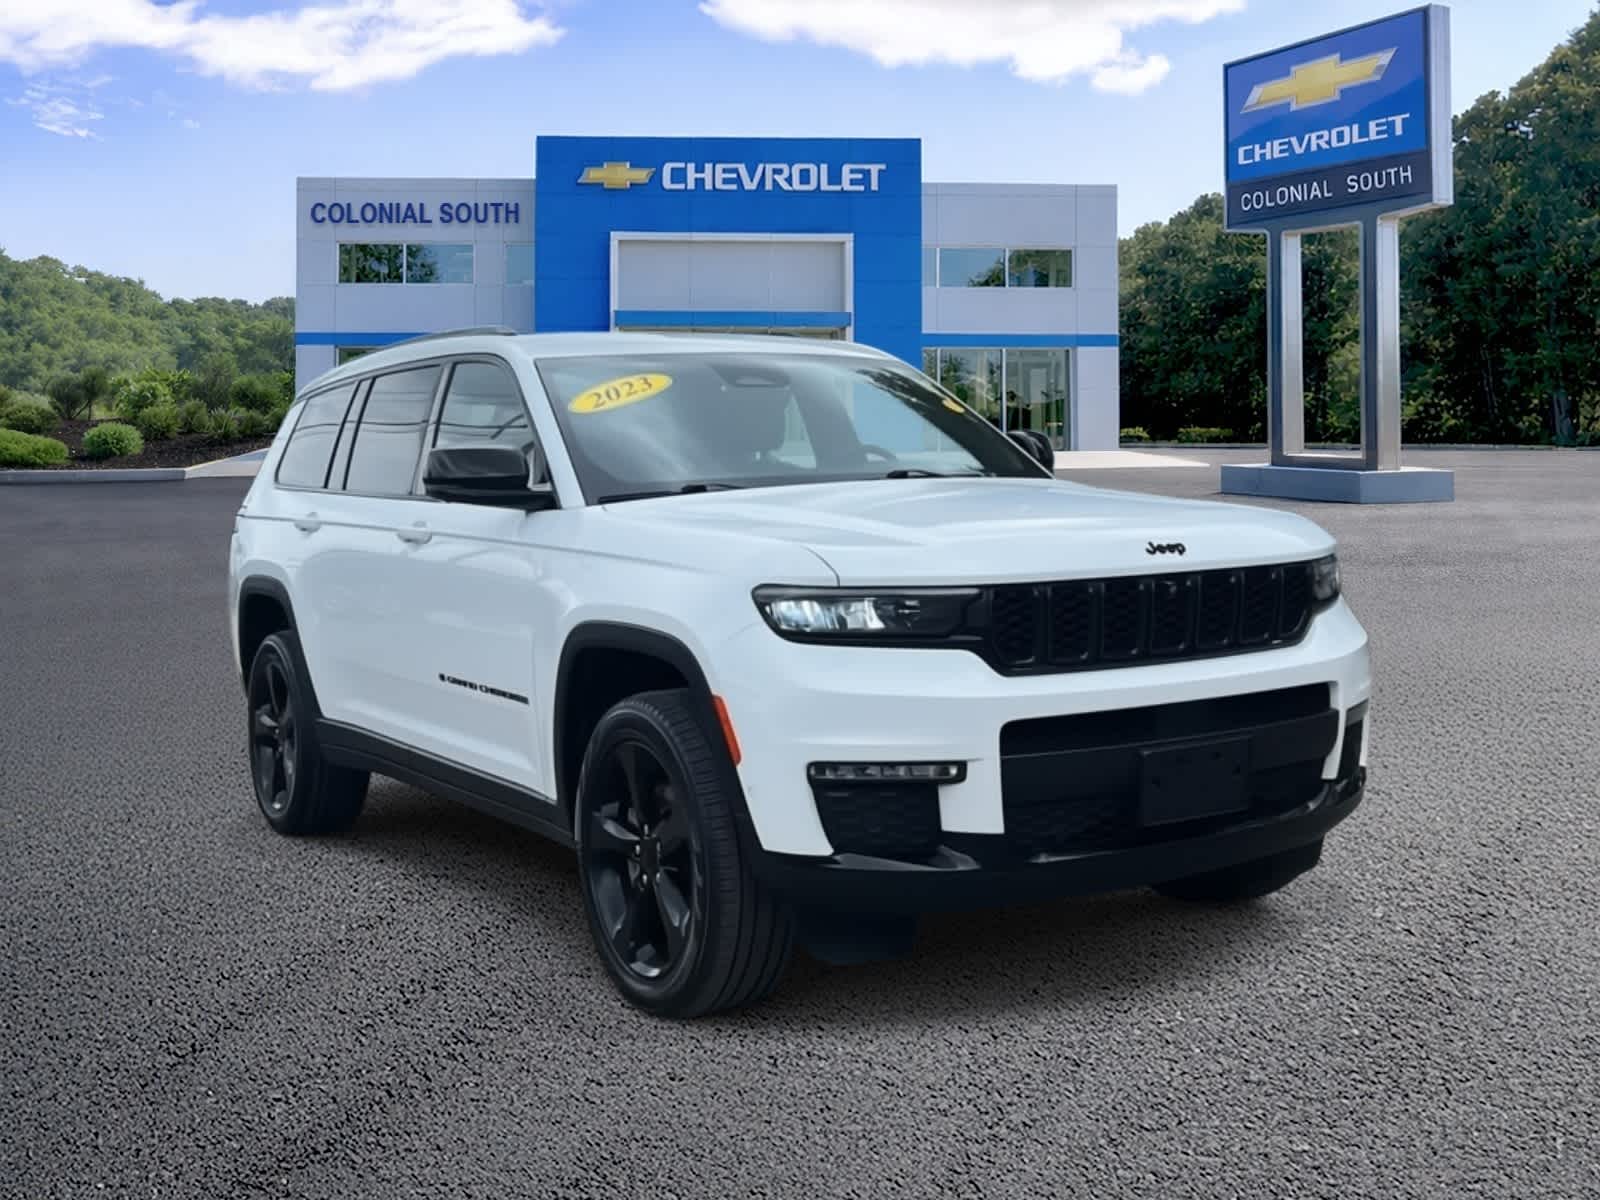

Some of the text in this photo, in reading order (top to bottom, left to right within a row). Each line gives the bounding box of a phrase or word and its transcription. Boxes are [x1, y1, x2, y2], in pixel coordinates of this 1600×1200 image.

[1237, 113, 1410, 165] CHEVROLET
[662, 162, 887, 192] CHEVROLET
[1240, 165, 1412, 211] COLONIAL SOUTH
[311, 203, 520, 224] COLONIAL SOUTH
[590, 376, 653, 409] 2023
[1145, 541, 1186, 556] Jeep
